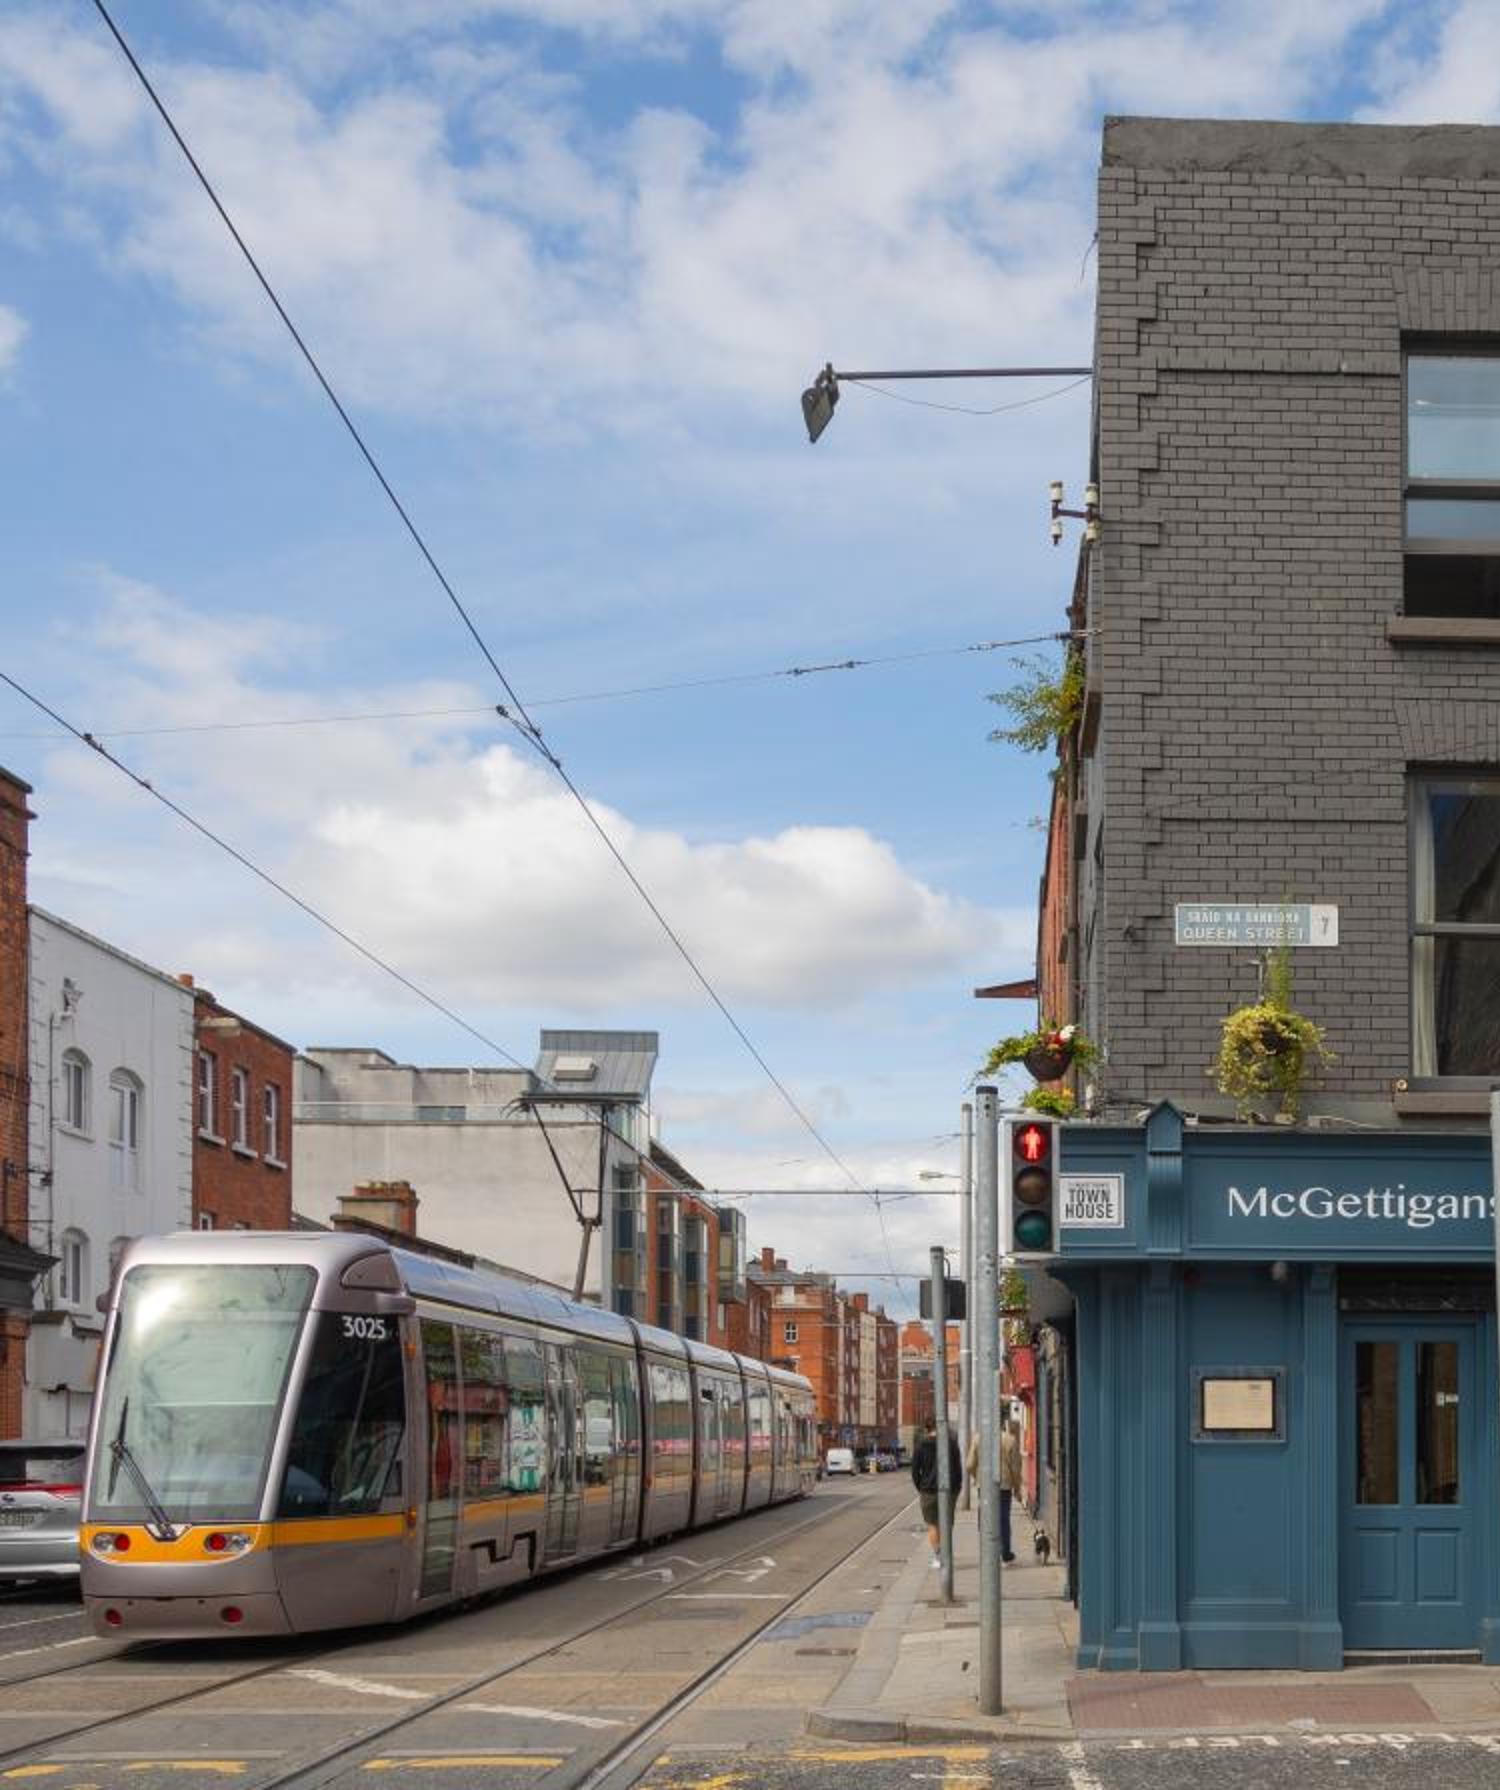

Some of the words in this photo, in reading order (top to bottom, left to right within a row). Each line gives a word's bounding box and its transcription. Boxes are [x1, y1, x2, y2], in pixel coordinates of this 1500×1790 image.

[1183, 927, 1237, 939] QUEEN
[1321, 915, 1330, 936] 7
[1068, 1188, 1111, 1203] TOWN
[1065, 1203, 1115, 1219] HOUSE
[341, 1315, 386, 1339] 3025
